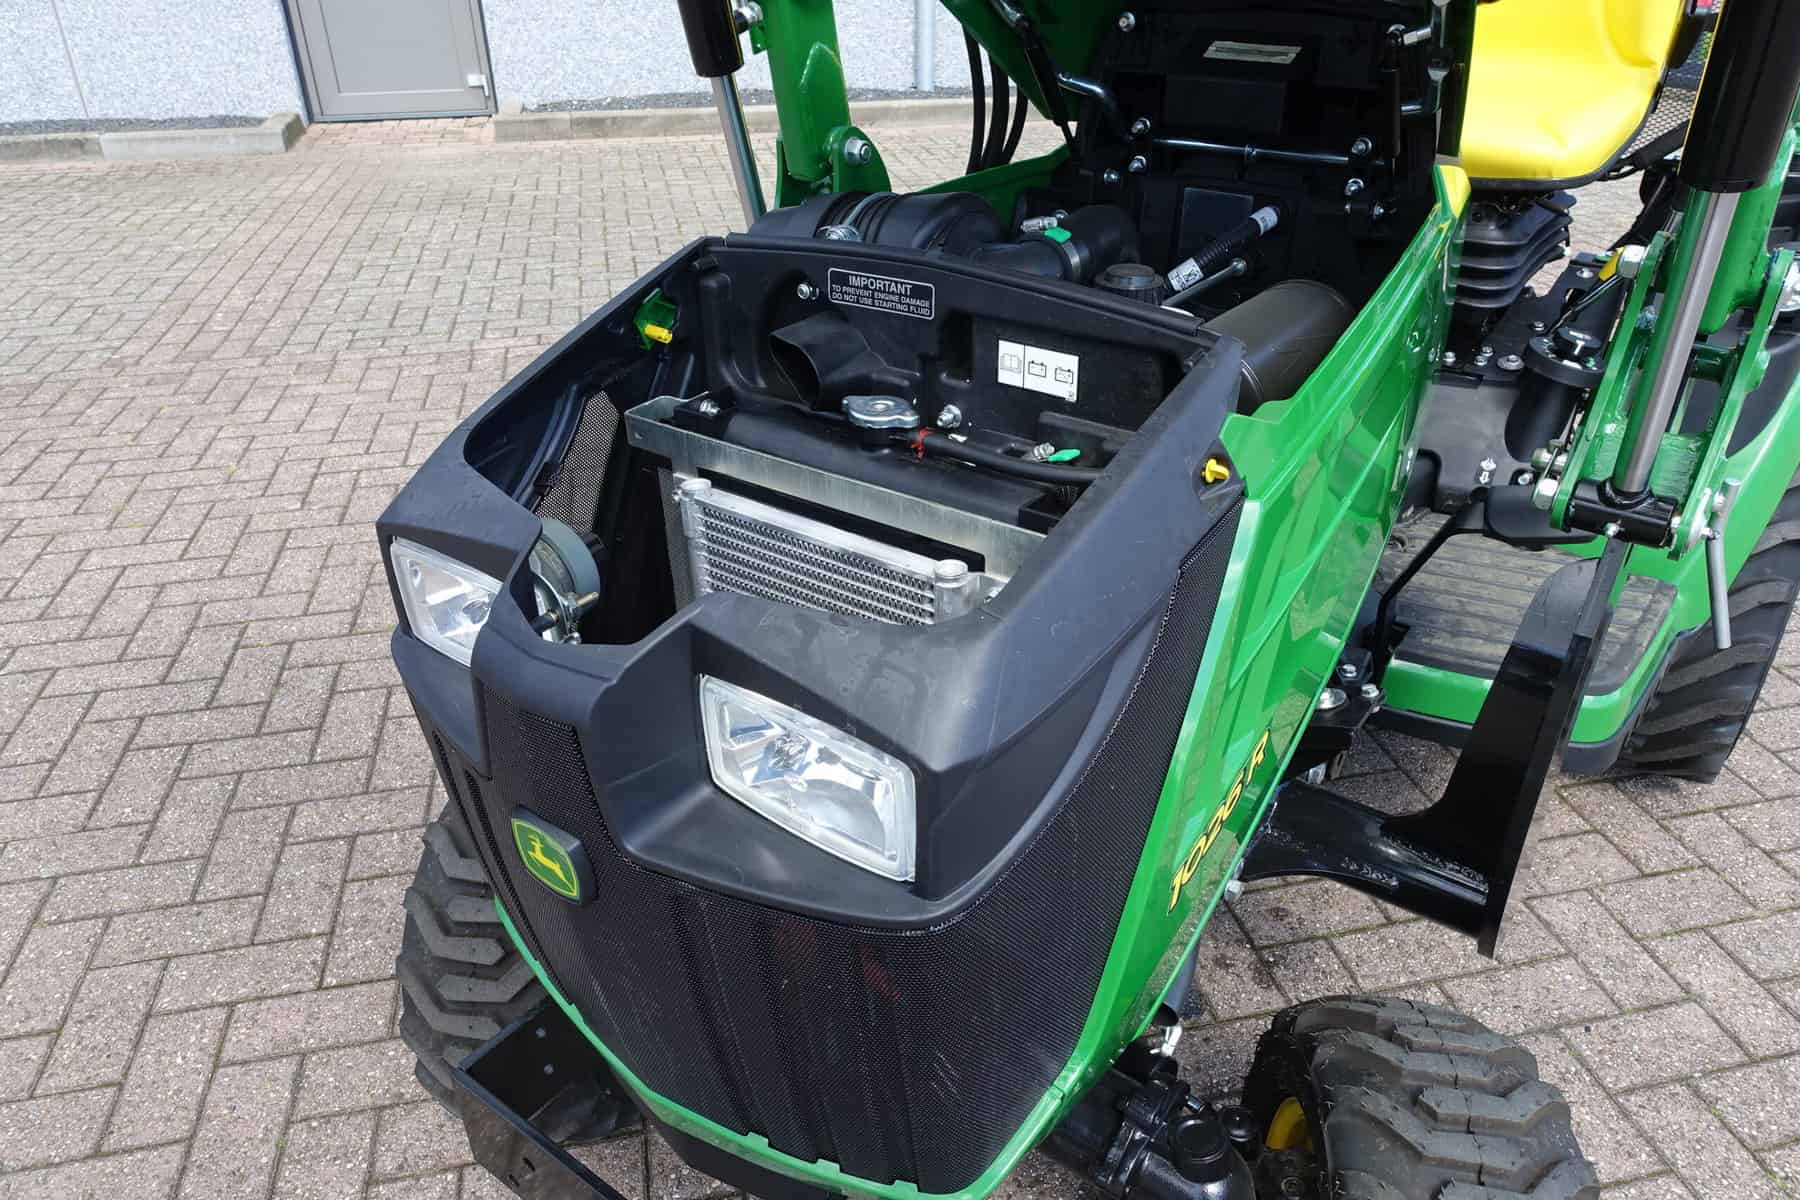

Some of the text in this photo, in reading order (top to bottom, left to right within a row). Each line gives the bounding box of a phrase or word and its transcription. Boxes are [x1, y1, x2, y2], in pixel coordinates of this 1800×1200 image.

[831, 284, 930, 308] TO PREVENT ENGINE DAMAGE
[848, 275, 913, 296] IMPORTANT
[831, 292, 930, 316] DO NOT USE STARTING FLUID
[1168, 728, 1271, 915] 1026R
